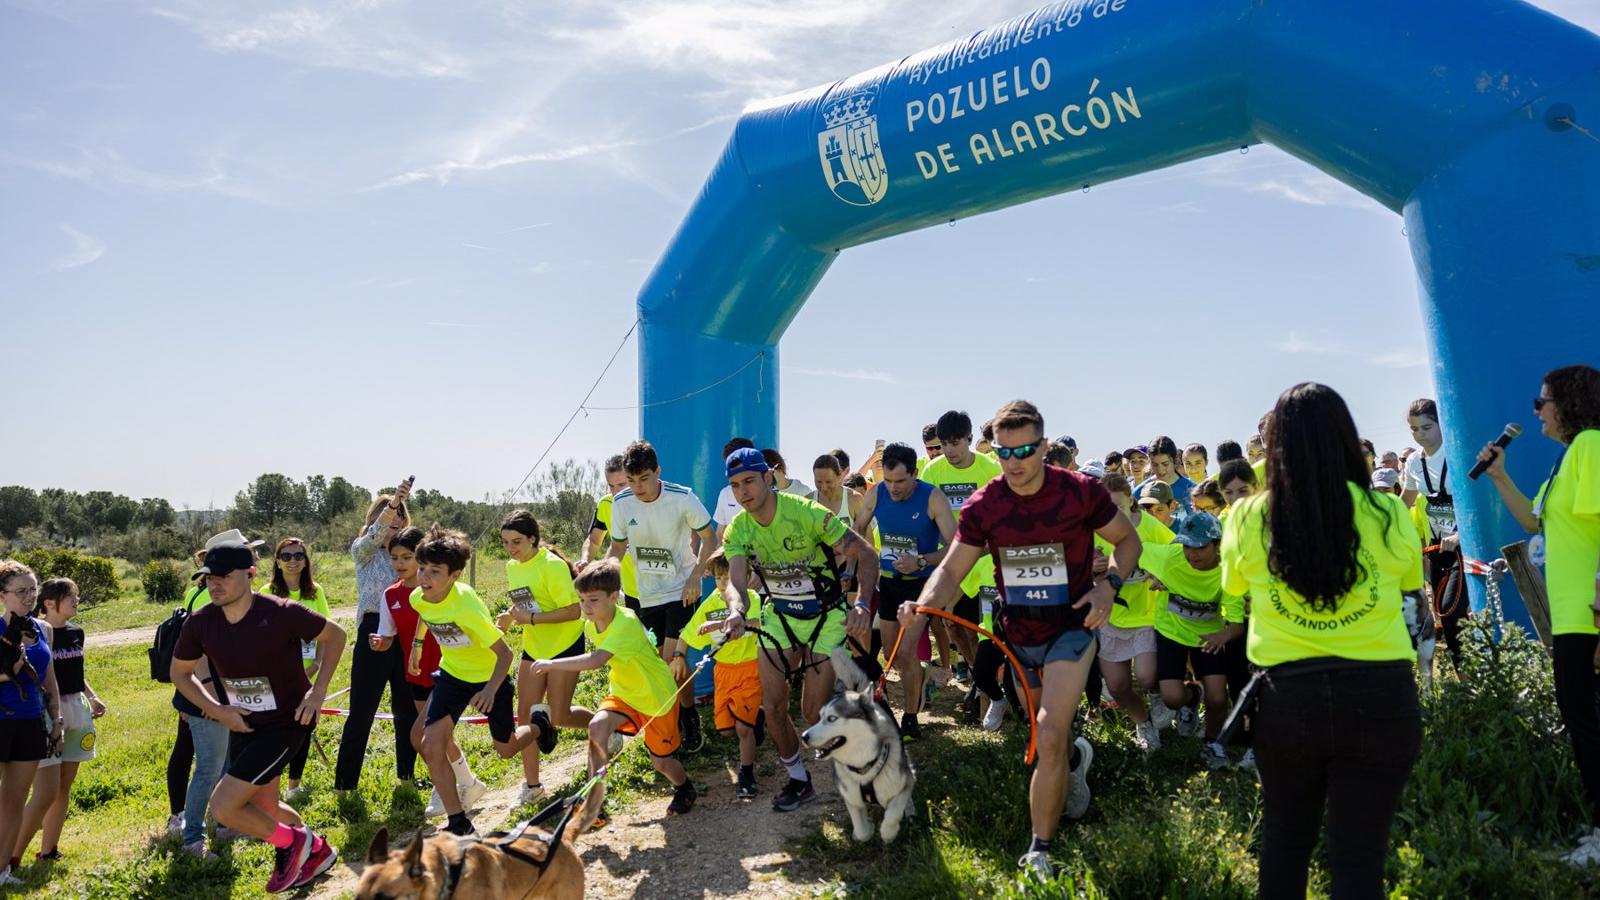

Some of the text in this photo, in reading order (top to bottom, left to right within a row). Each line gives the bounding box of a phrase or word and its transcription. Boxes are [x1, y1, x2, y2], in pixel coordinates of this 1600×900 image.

[909, 0, 1127, 85] Ayuntamiento de
[906, 56, 1051, 133] POZUELO
[915, 77, 1142, 180] DE ALARCÓN
[884, 534, 913, 543] DACIA
[1005, 546, 1056, 557] DACIA
[647, 560, 668, 569] 174
[765, 567, 802, 576] DACIA
[1015, 566, 1053, 579] 250
[775, 579, 802, 589] 249
[1025, 589, 1049, 600] 441
[787, 602, 804, 611] 440
[235, 694, 263, 704] 006
